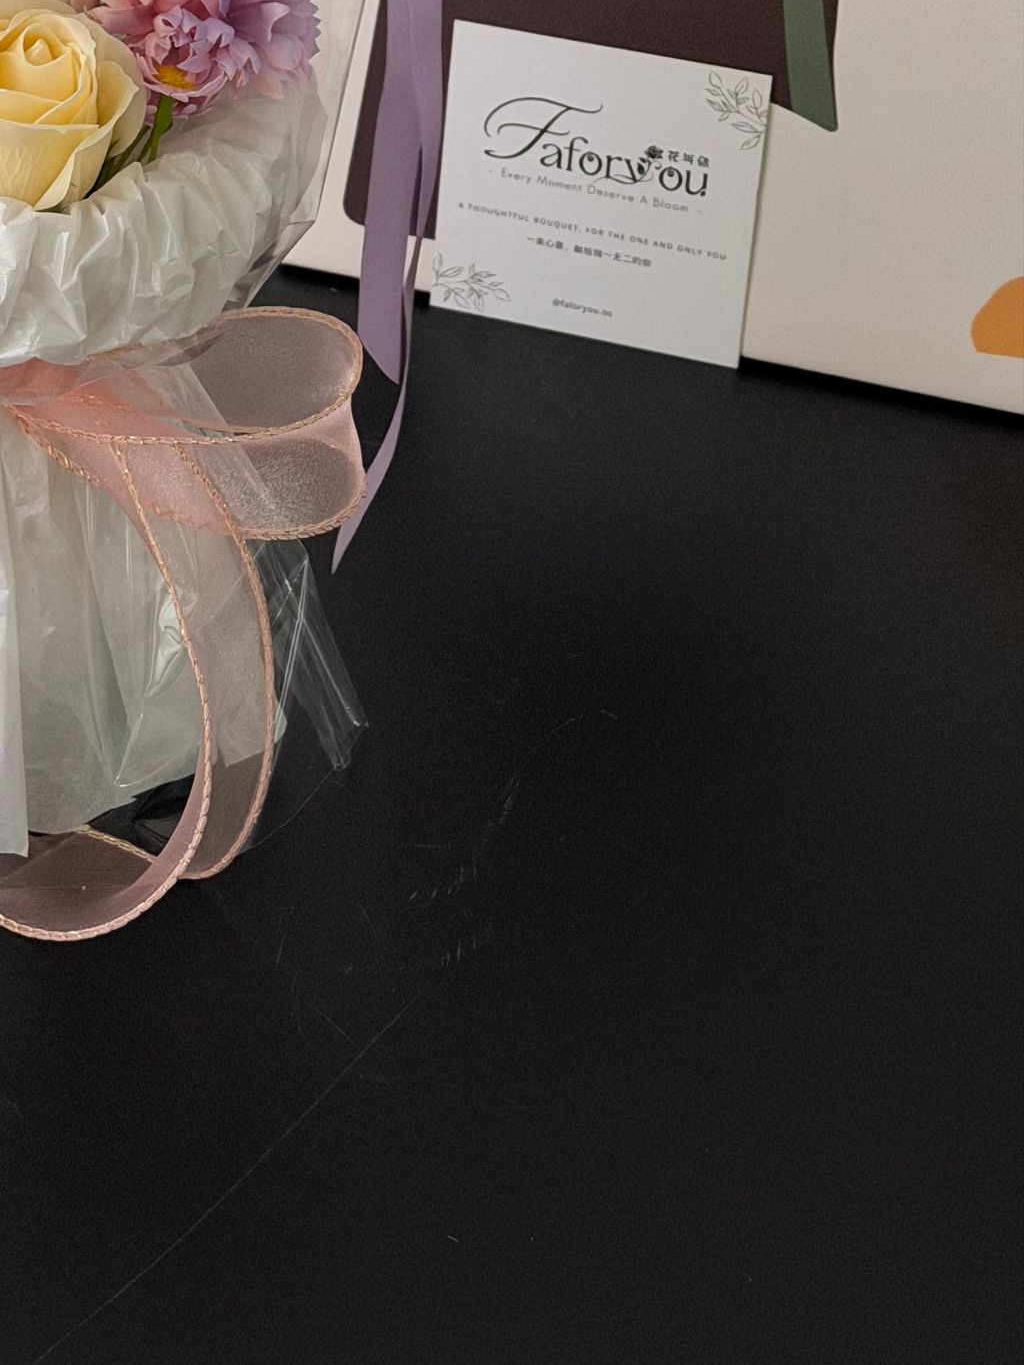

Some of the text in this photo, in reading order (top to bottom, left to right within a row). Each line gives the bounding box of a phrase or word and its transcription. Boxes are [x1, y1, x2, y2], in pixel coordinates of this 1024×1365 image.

[501, 167, 689, 212] Every Moment Deserve A Bloom
[468, 203, 529, 222] THOUGHTFUL
[585, 226, 604, 236] FOR
[608, 230, 625, 241] THE
[629, 235, 648, 245] ONE
[652, 240, 673, 250] AND
[677, 245, 702, 256] ONLY
[707, 250, 727, 260] YOU
